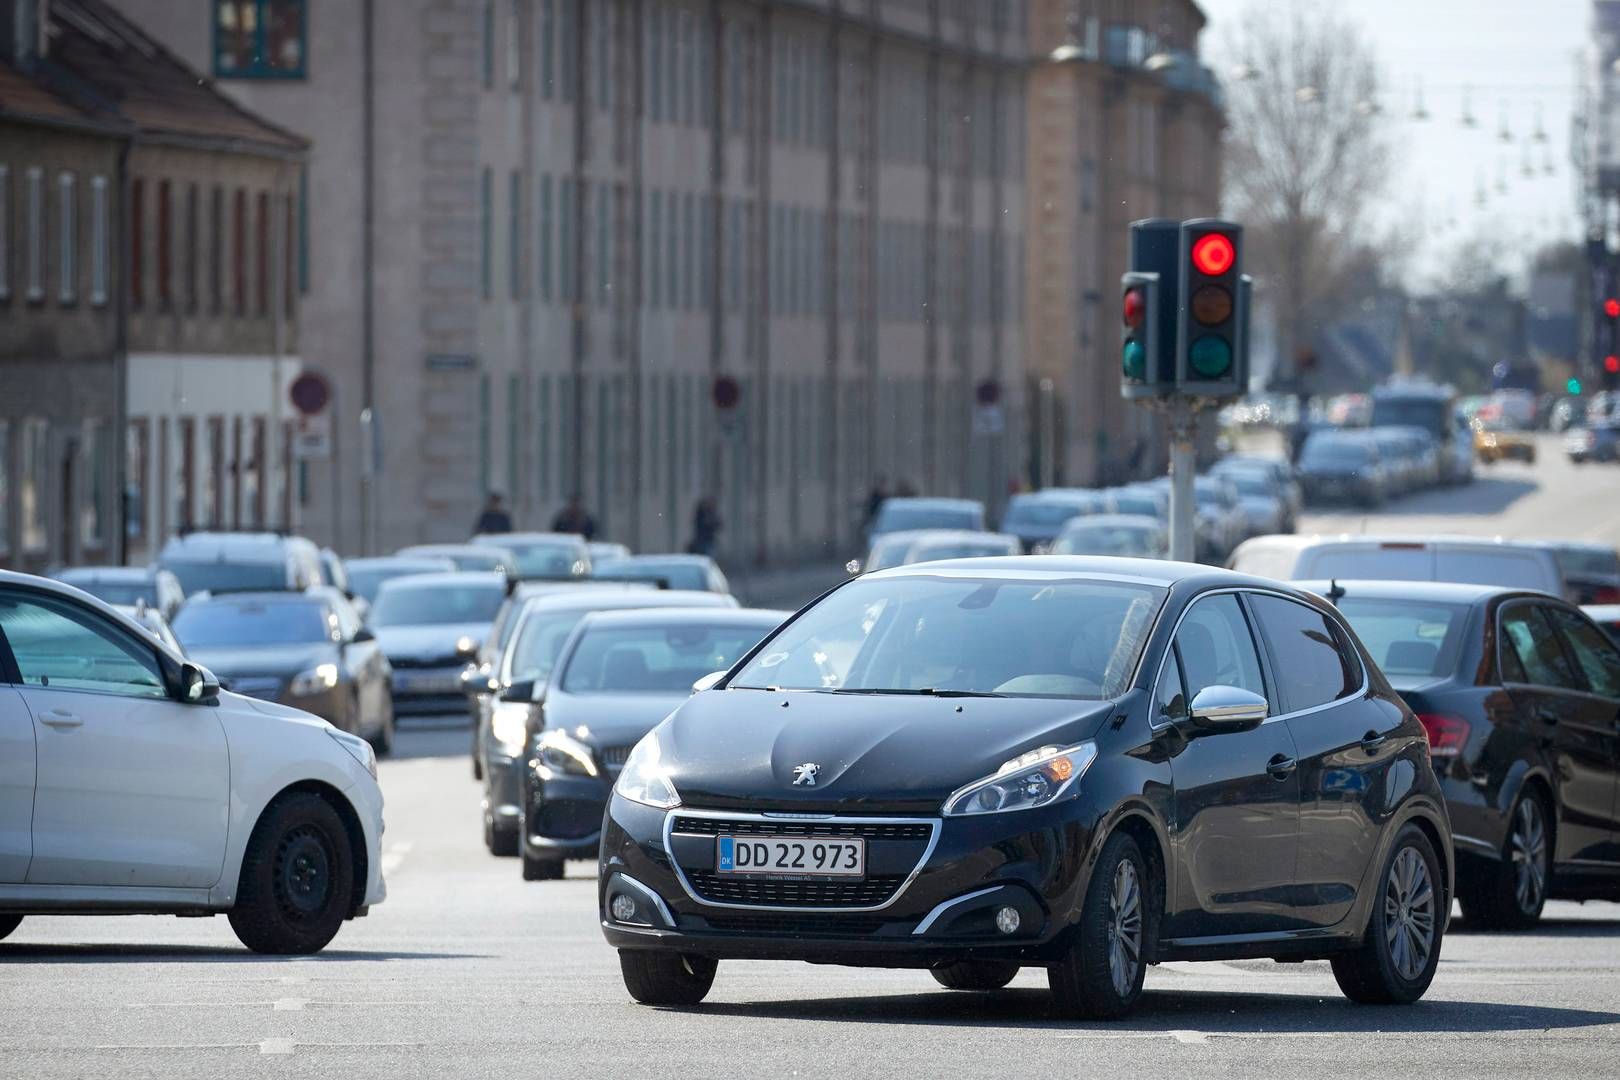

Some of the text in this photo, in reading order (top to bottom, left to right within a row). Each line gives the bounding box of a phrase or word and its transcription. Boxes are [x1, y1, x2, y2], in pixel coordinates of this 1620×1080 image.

[721, 857, 731, 865] DK
[736, 842, 858, 869] DD 22 973
